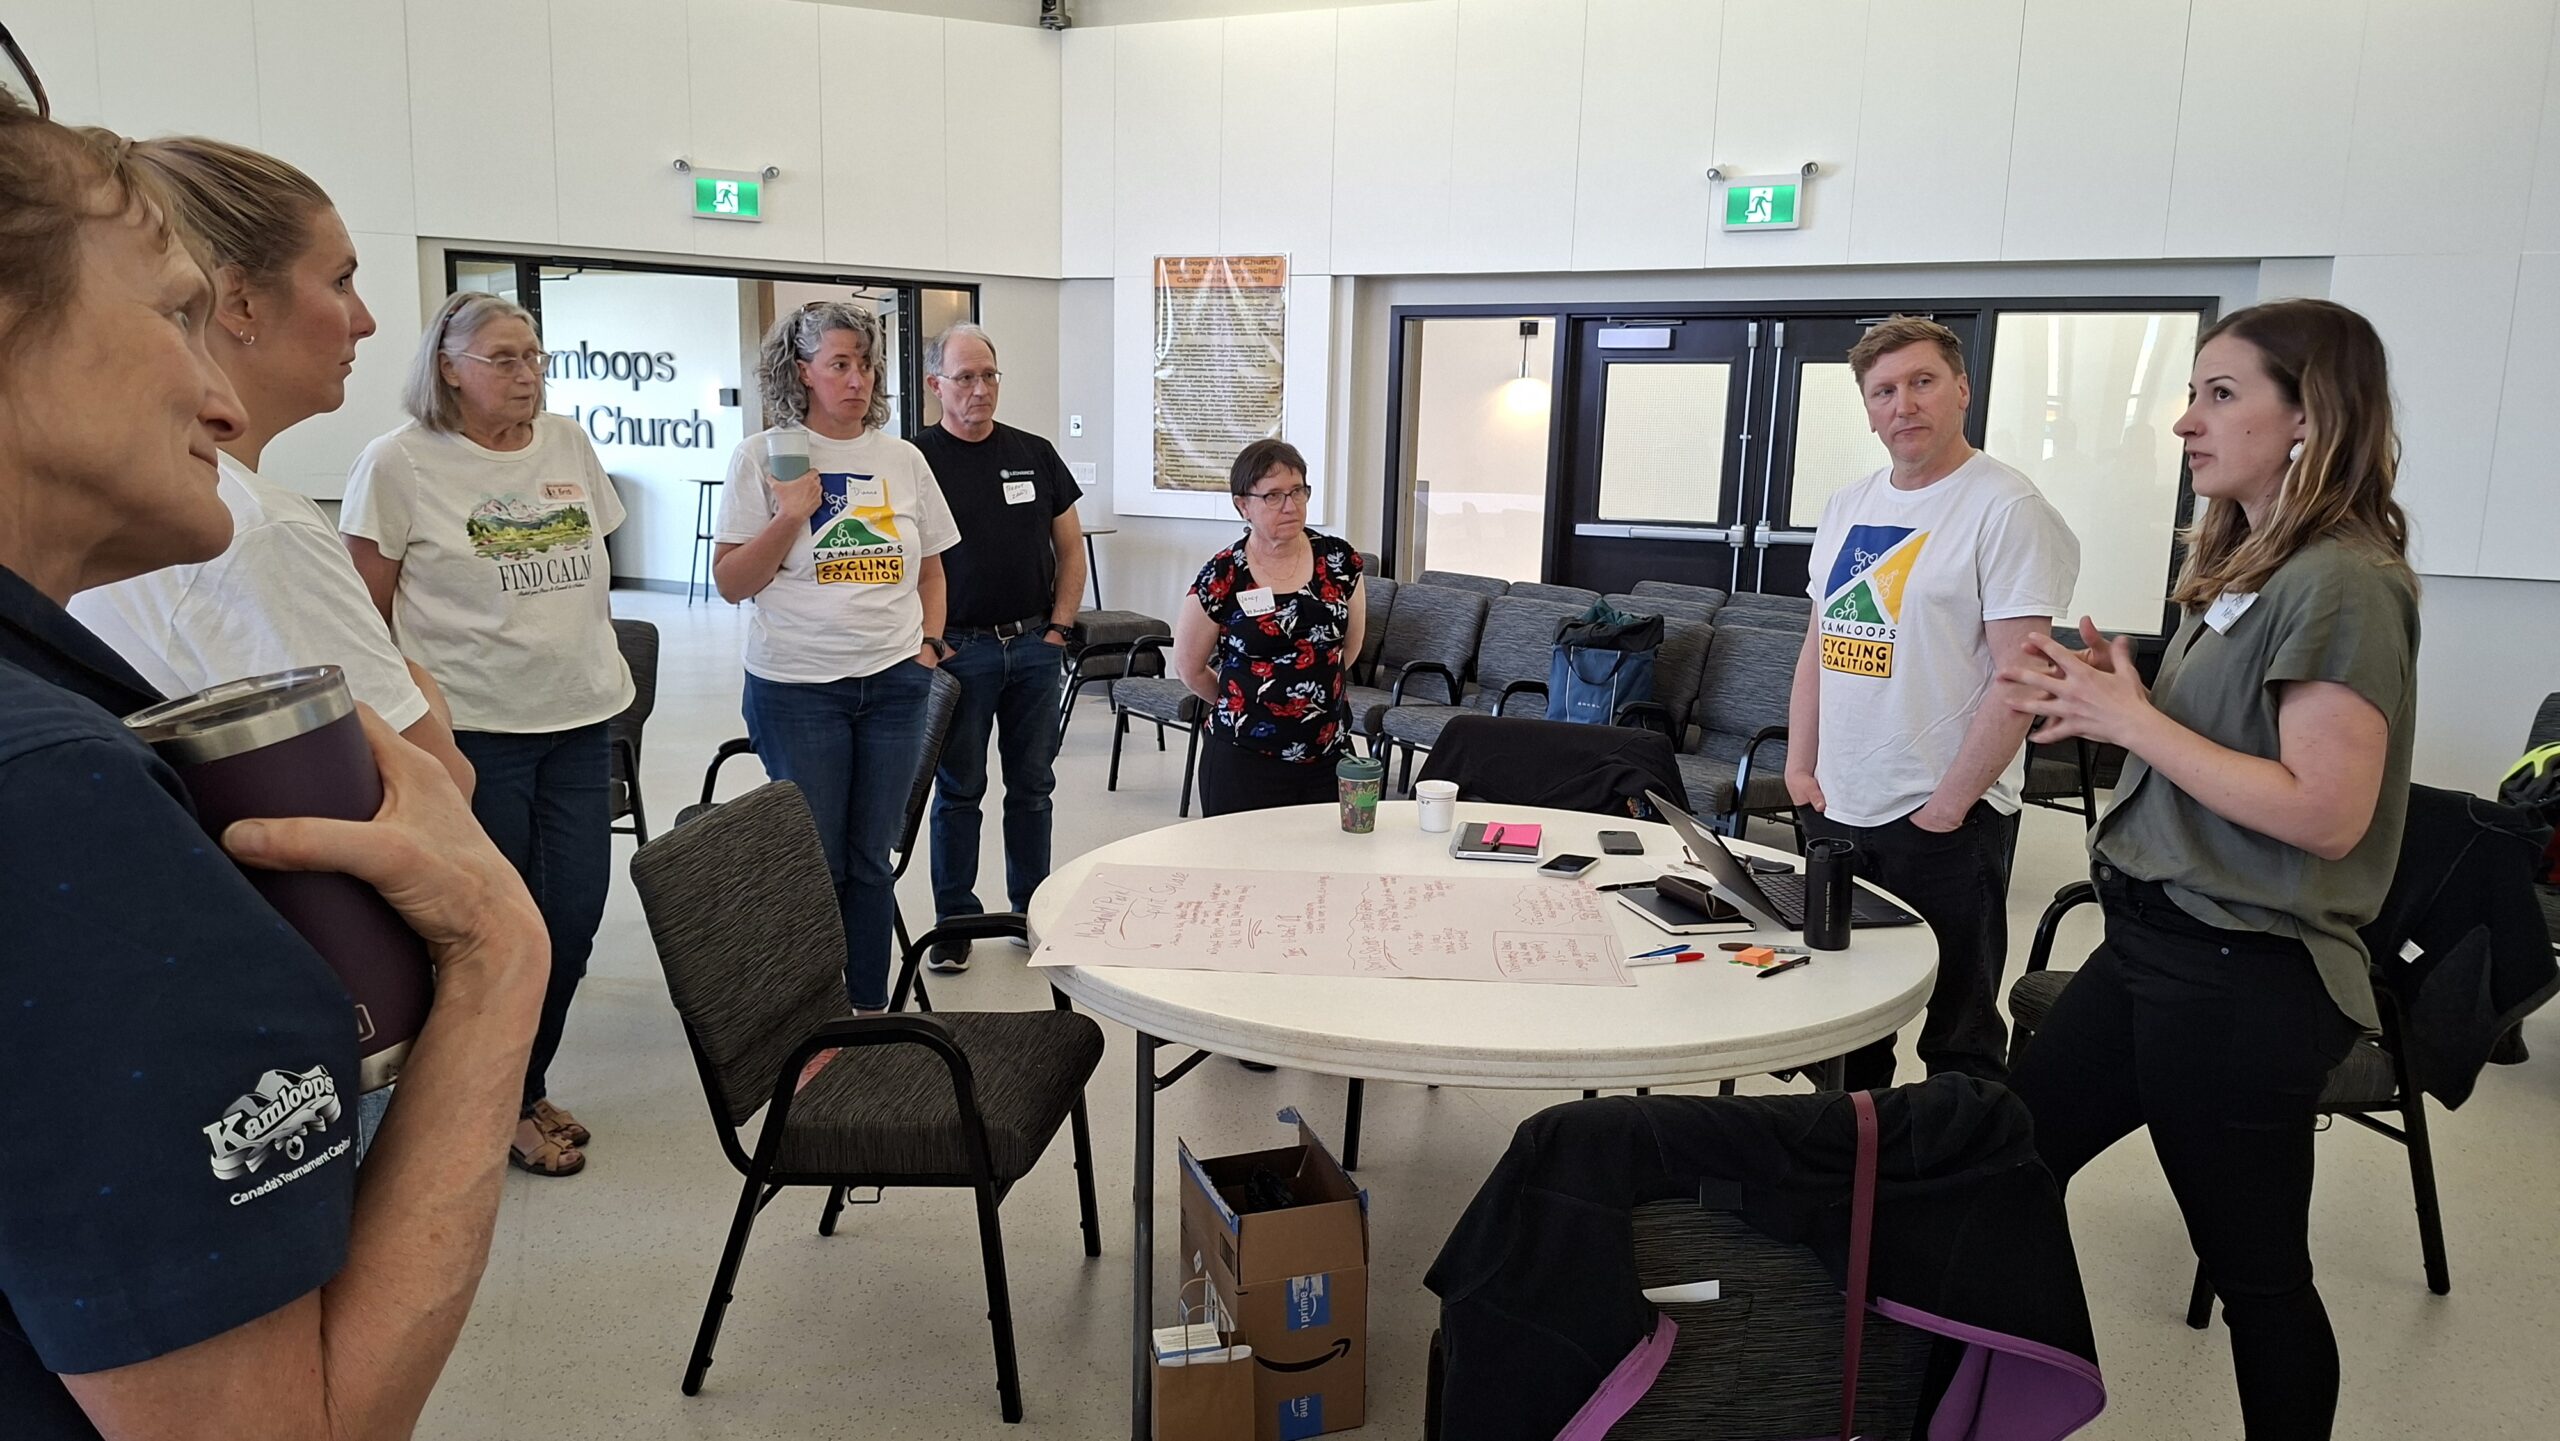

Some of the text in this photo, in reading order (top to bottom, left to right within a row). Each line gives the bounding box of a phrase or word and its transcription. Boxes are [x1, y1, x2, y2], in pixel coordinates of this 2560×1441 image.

[1212, 258, 1241, 267] Unted
[1244, 258, 1277, 266] Church
[1223, 267, 1279, 277] econciling
[546, 340, 677, 391] mloops
[587, 404, 715, 449] Church
[812, 544, 904, 561] KAMLOOPS
[498, 561, 543, 592] FIND
[822, 559, 900, 573] CYCLING
[822, 570, 900, 581] COALITION
[1821, 621, 1897, 640] KAMLOOPS
[1823, 638, 1887, 661] CYCLING
[1822, 654, 1886, 673] COALITION
[202, 1075, 335, 1160] Kamloops
[229, 1177, 284, 1206] Canada's
[279, 1150, 332, 1184] Tournament
[1298, 1291, 1311, 1323] prime
[1300, 1395, 1311, 1418] ime
